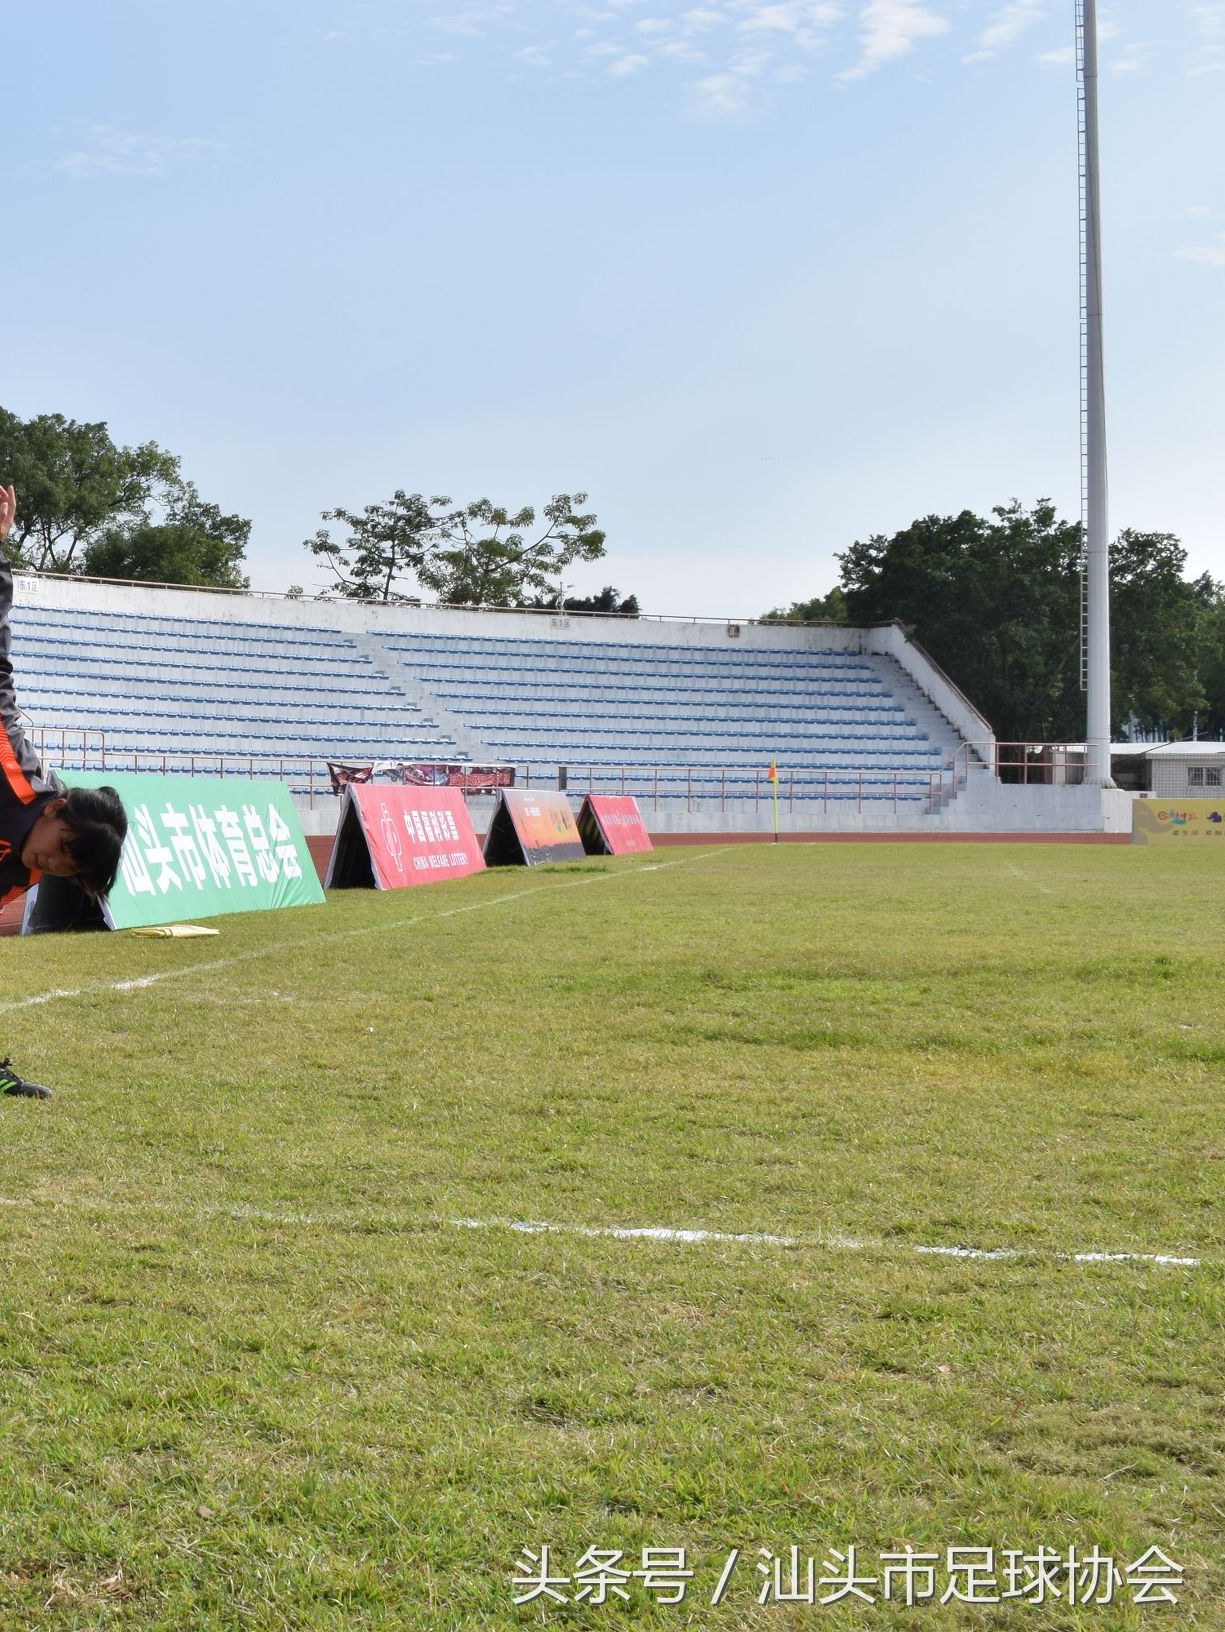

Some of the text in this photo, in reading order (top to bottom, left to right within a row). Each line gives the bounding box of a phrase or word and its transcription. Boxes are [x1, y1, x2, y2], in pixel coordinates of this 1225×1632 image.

[404, 810, 460, 844] 中国福利彩票
